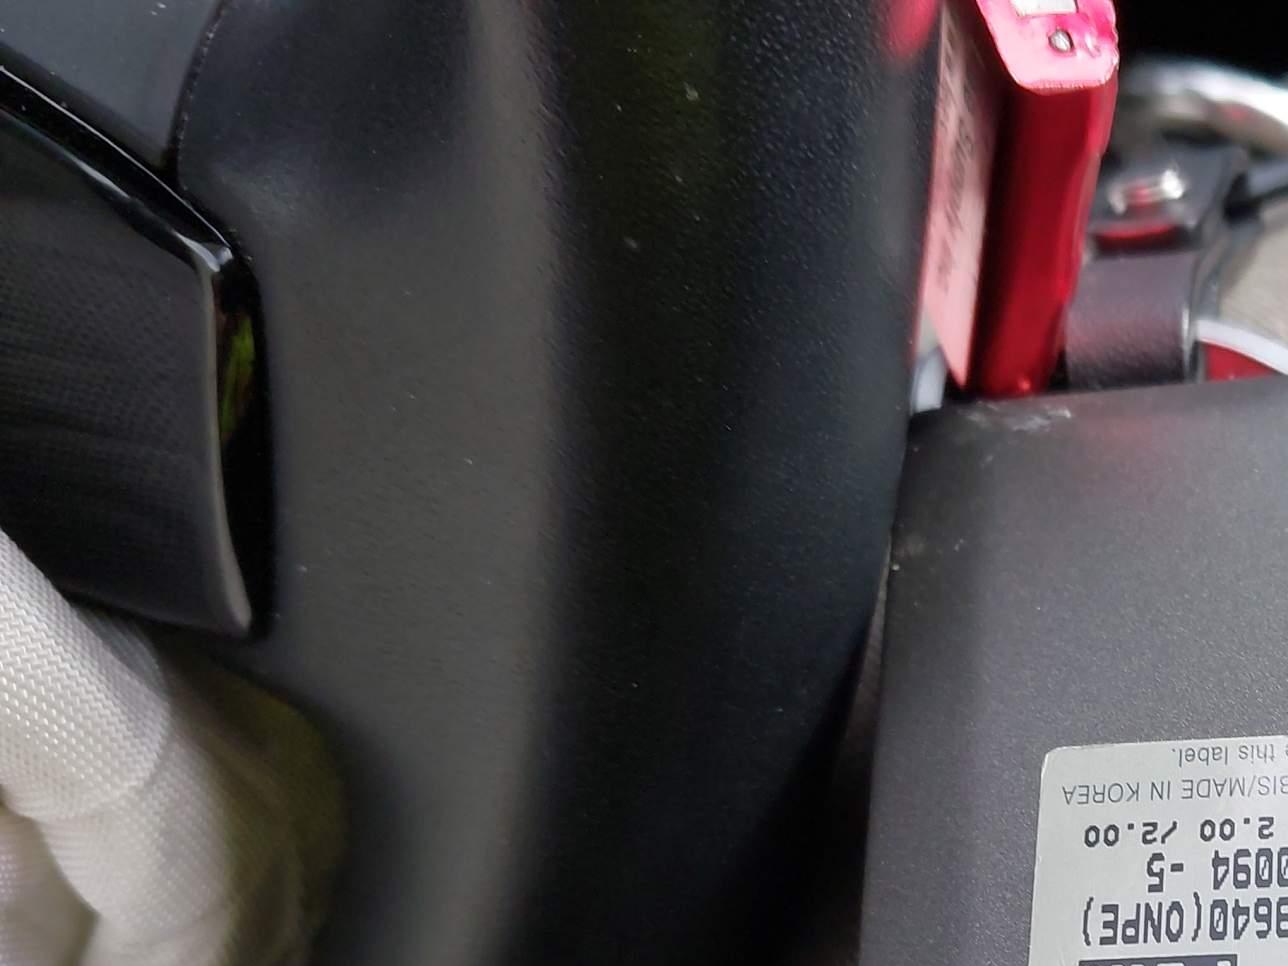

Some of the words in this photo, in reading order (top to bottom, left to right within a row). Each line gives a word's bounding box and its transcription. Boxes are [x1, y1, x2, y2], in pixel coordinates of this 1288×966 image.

[1171, 746, 1229, 768] label.
[1238, 743, 1276, 764] this
[1061, 782, 1141, 805] KOREA
[1150, 780, 1172, 801] IN
[1084, 820, 1178, 848] /2.00
[1199, 816, 1275, 841] 2.00
[1146, 852, 1184, 893] -5
